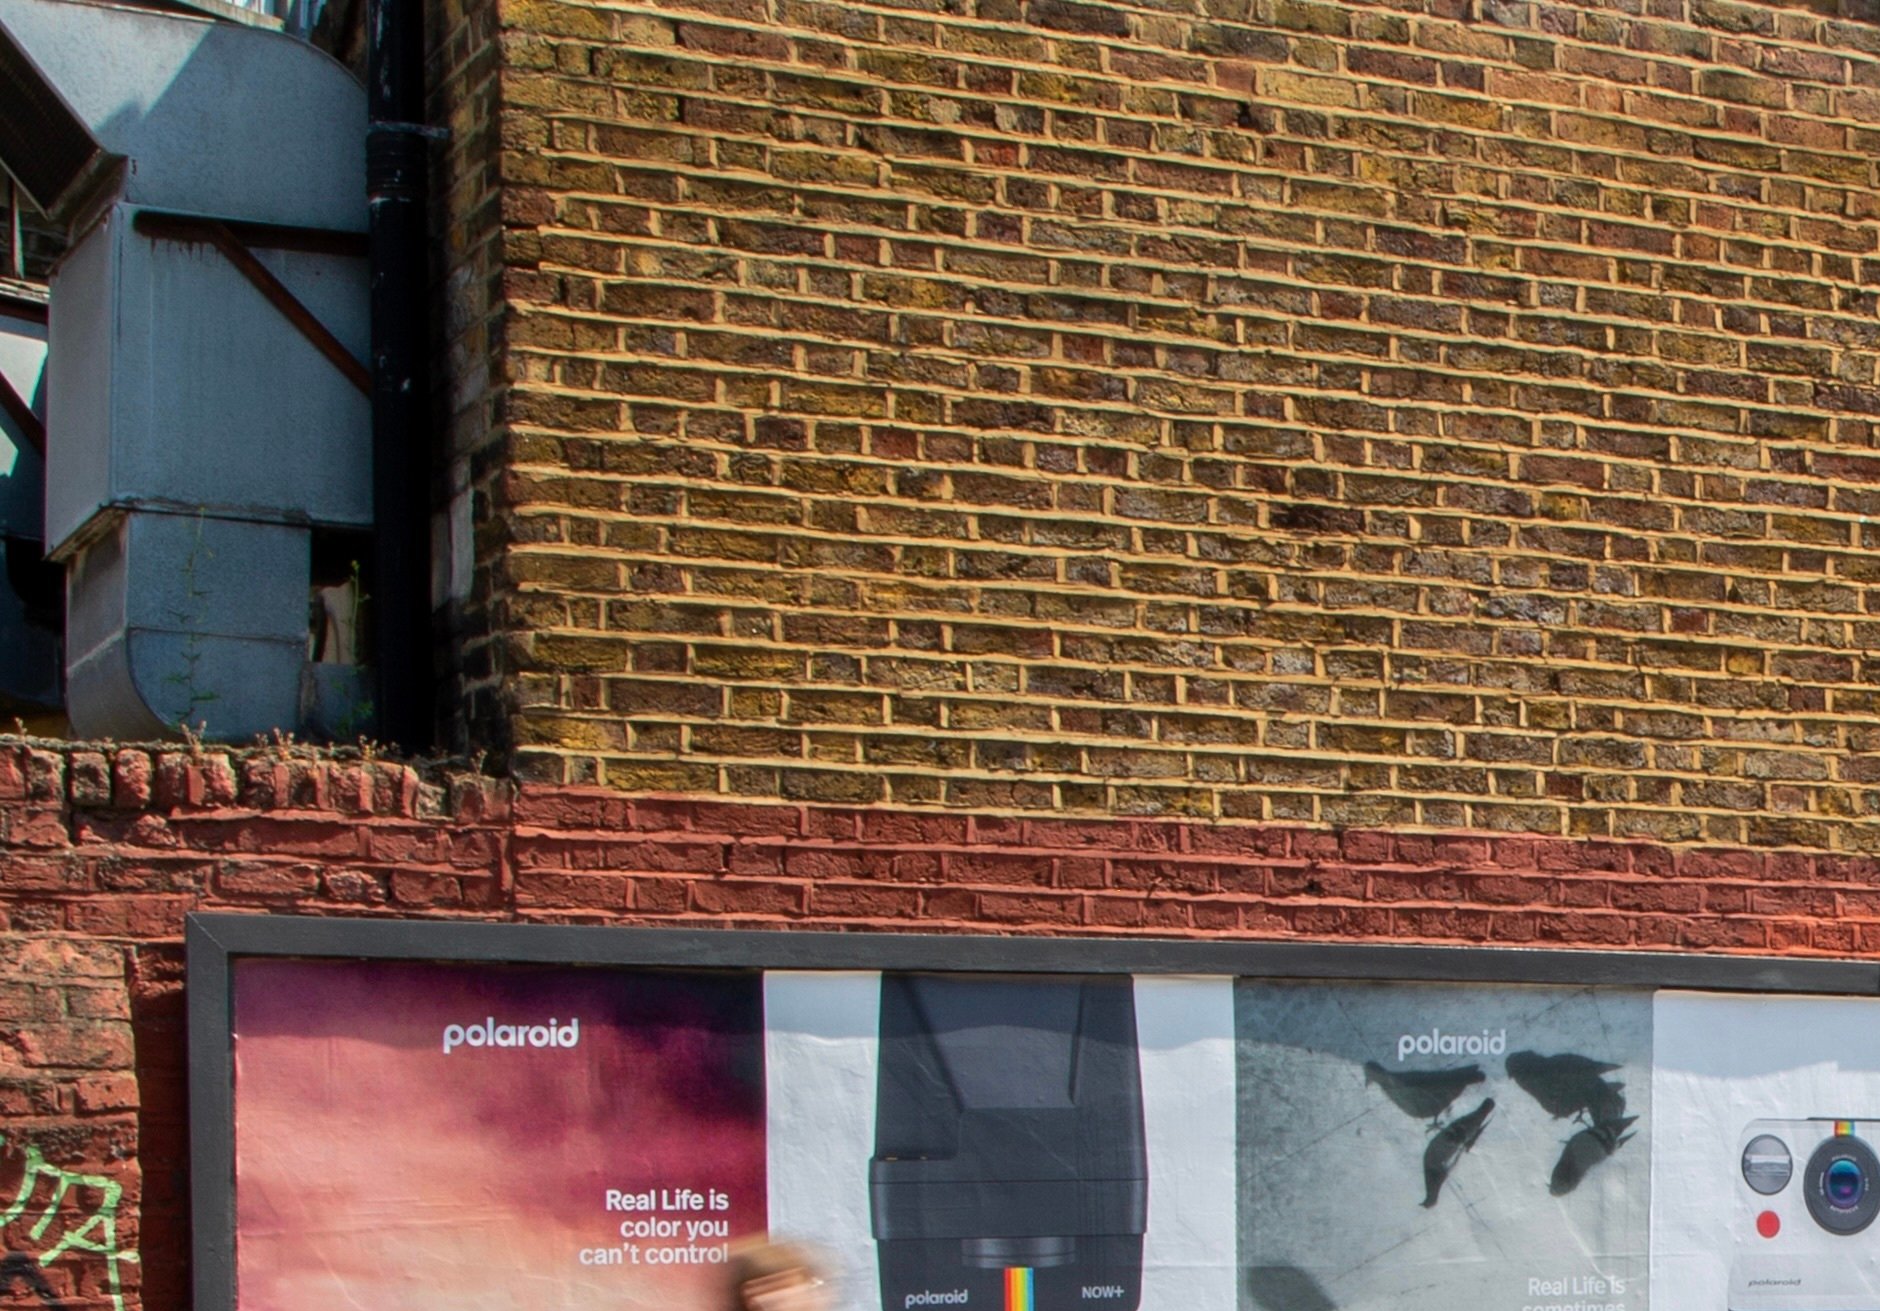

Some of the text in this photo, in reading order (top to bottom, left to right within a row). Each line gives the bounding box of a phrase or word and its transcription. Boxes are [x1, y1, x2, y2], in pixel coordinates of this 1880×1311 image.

[443, 1017, 579, 1054] polaroid
[1398, 1029, 1506, 1061] polaroid
[605, 1189, 729, 1211] Real Life is
[620, 1216, 729, 1242] color you
[579, 1243, 729, 1265] can't control
[1528, 1277, 1626, 1297] Real Life is
[1747, 1277, 1803, 1288] polaroid
[905, 1285, 1125, 1309] polaroid NOW+
